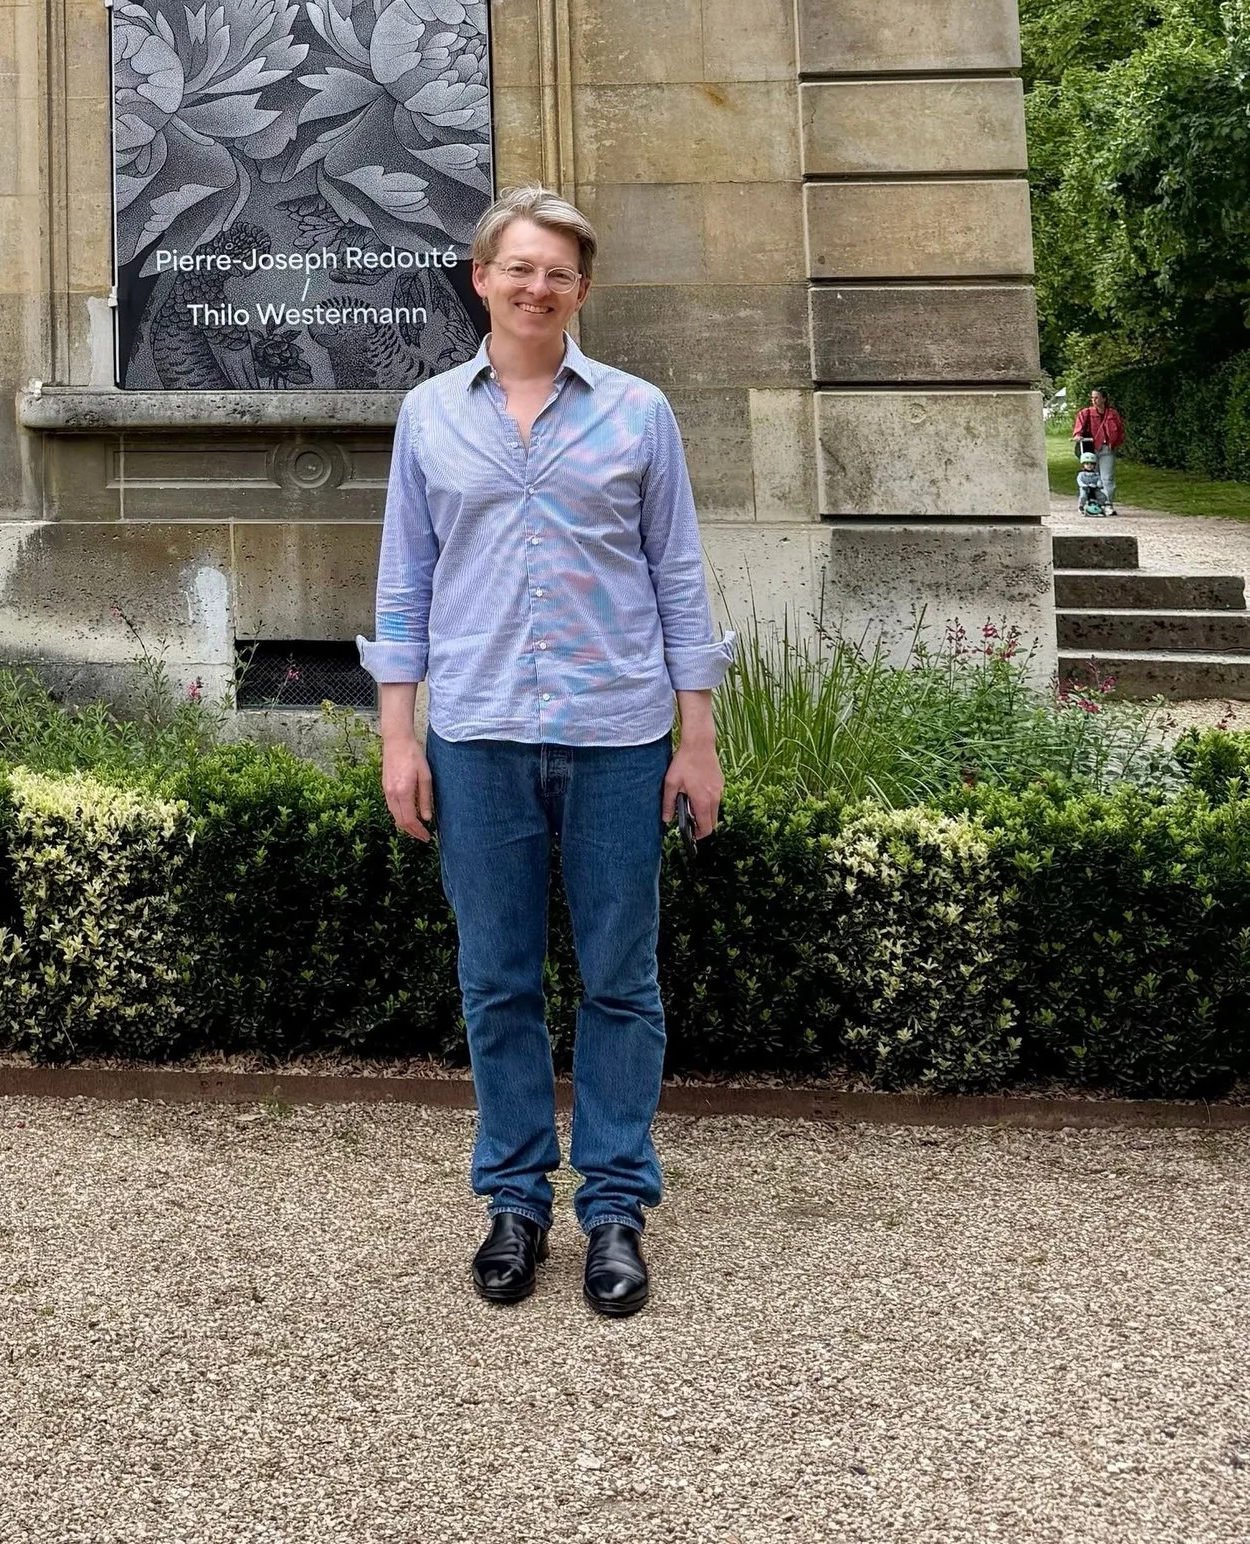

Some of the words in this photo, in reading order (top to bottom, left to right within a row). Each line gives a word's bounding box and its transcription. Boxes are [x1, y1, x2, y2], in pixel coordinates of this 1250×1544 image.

[155, 247, 338, 275] Pierre-Joseph
[346, 244, 458, 269] Redouté
[186, 303, 250, 326] Thilo
[256, 303, 428, 326] Westermann
